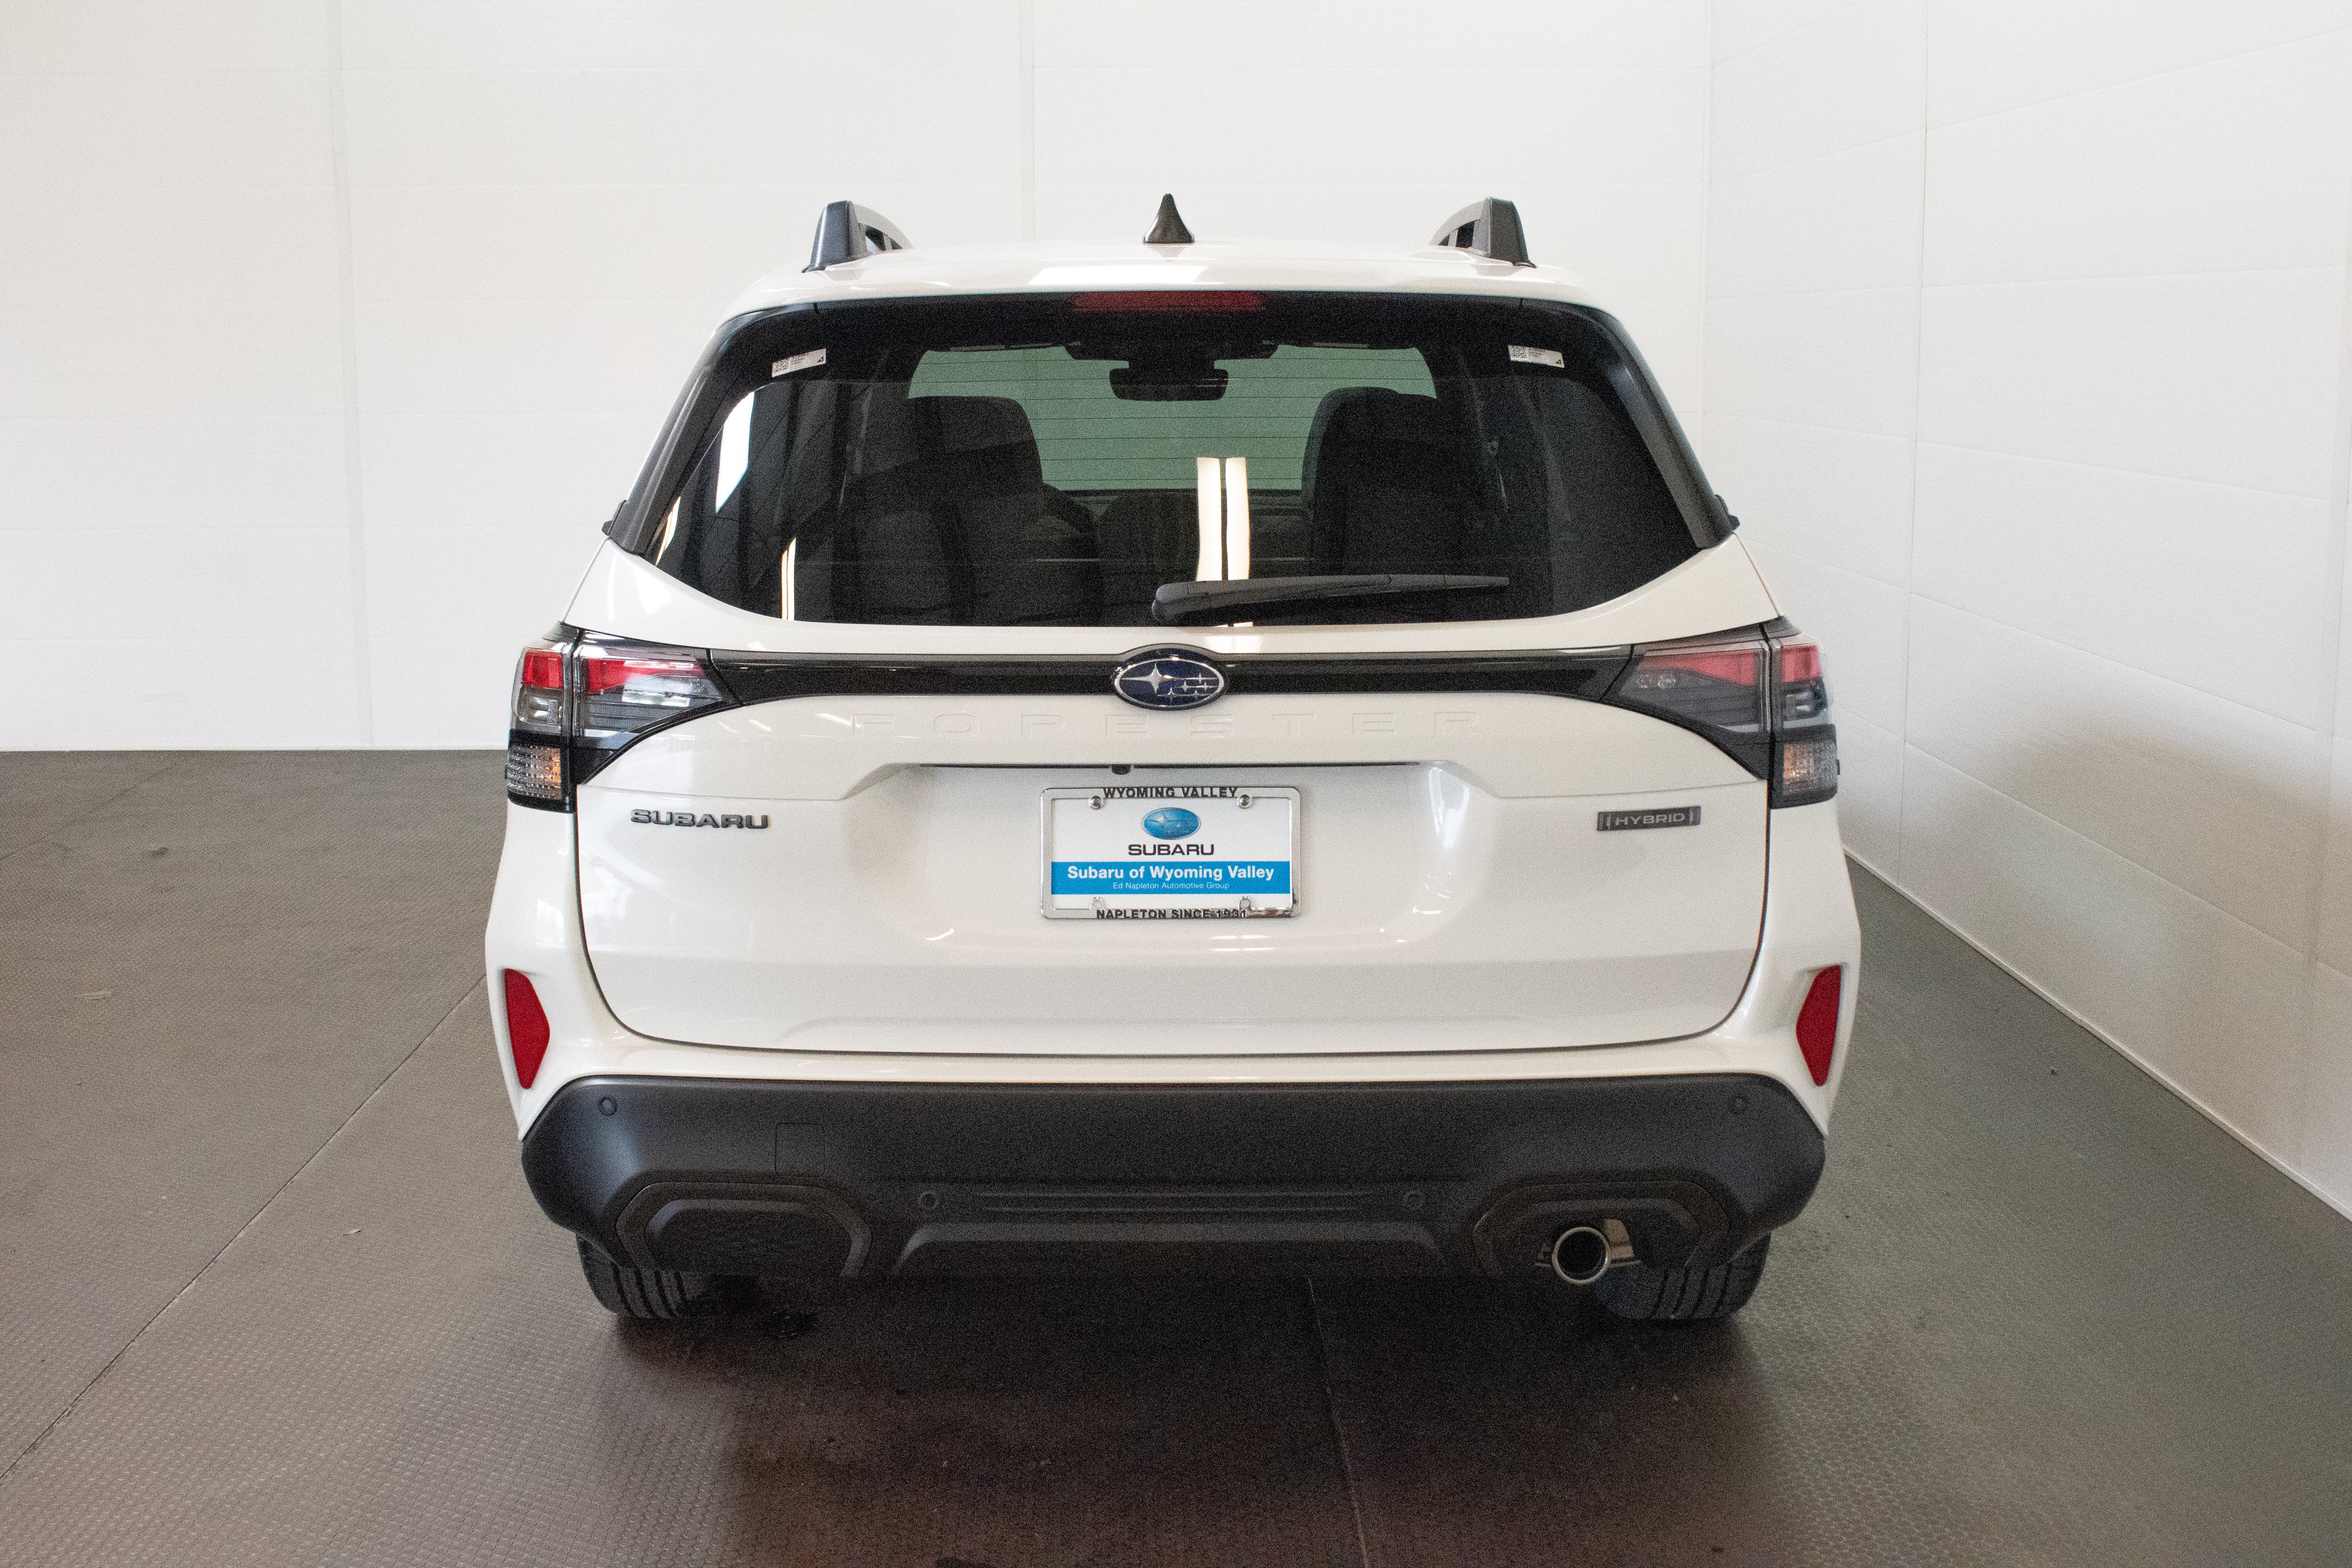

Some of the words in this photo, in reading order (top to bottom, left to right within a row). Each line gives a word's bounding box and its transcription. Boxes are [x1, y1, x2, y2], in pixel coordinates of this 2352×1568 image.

[850, 711, 1480, 738] FORESTER
[1102, 787, 1175, 798] WYOMING
[1181, 787, 1239, 798] VALLEY
[630, 808, 771, 830] SUBARU
[1615, 812, 1686, 826] HYBRID
[1128, 843, 1214, 855] SUBARU
[1067, 865, 1124, 879] Subaru
[1129, 865, 1146, 879] of
[1150, 865, 1223, 882] Wyoming
[1227, 865, 1275, 881] Valley
[1125, 882, 1159, 891] Napleton
[1206, 882, 1230, 891] Group
[1096, 909, 1166, 919] NAPLETON
[1171, 909, 1210, 919] SINCE
